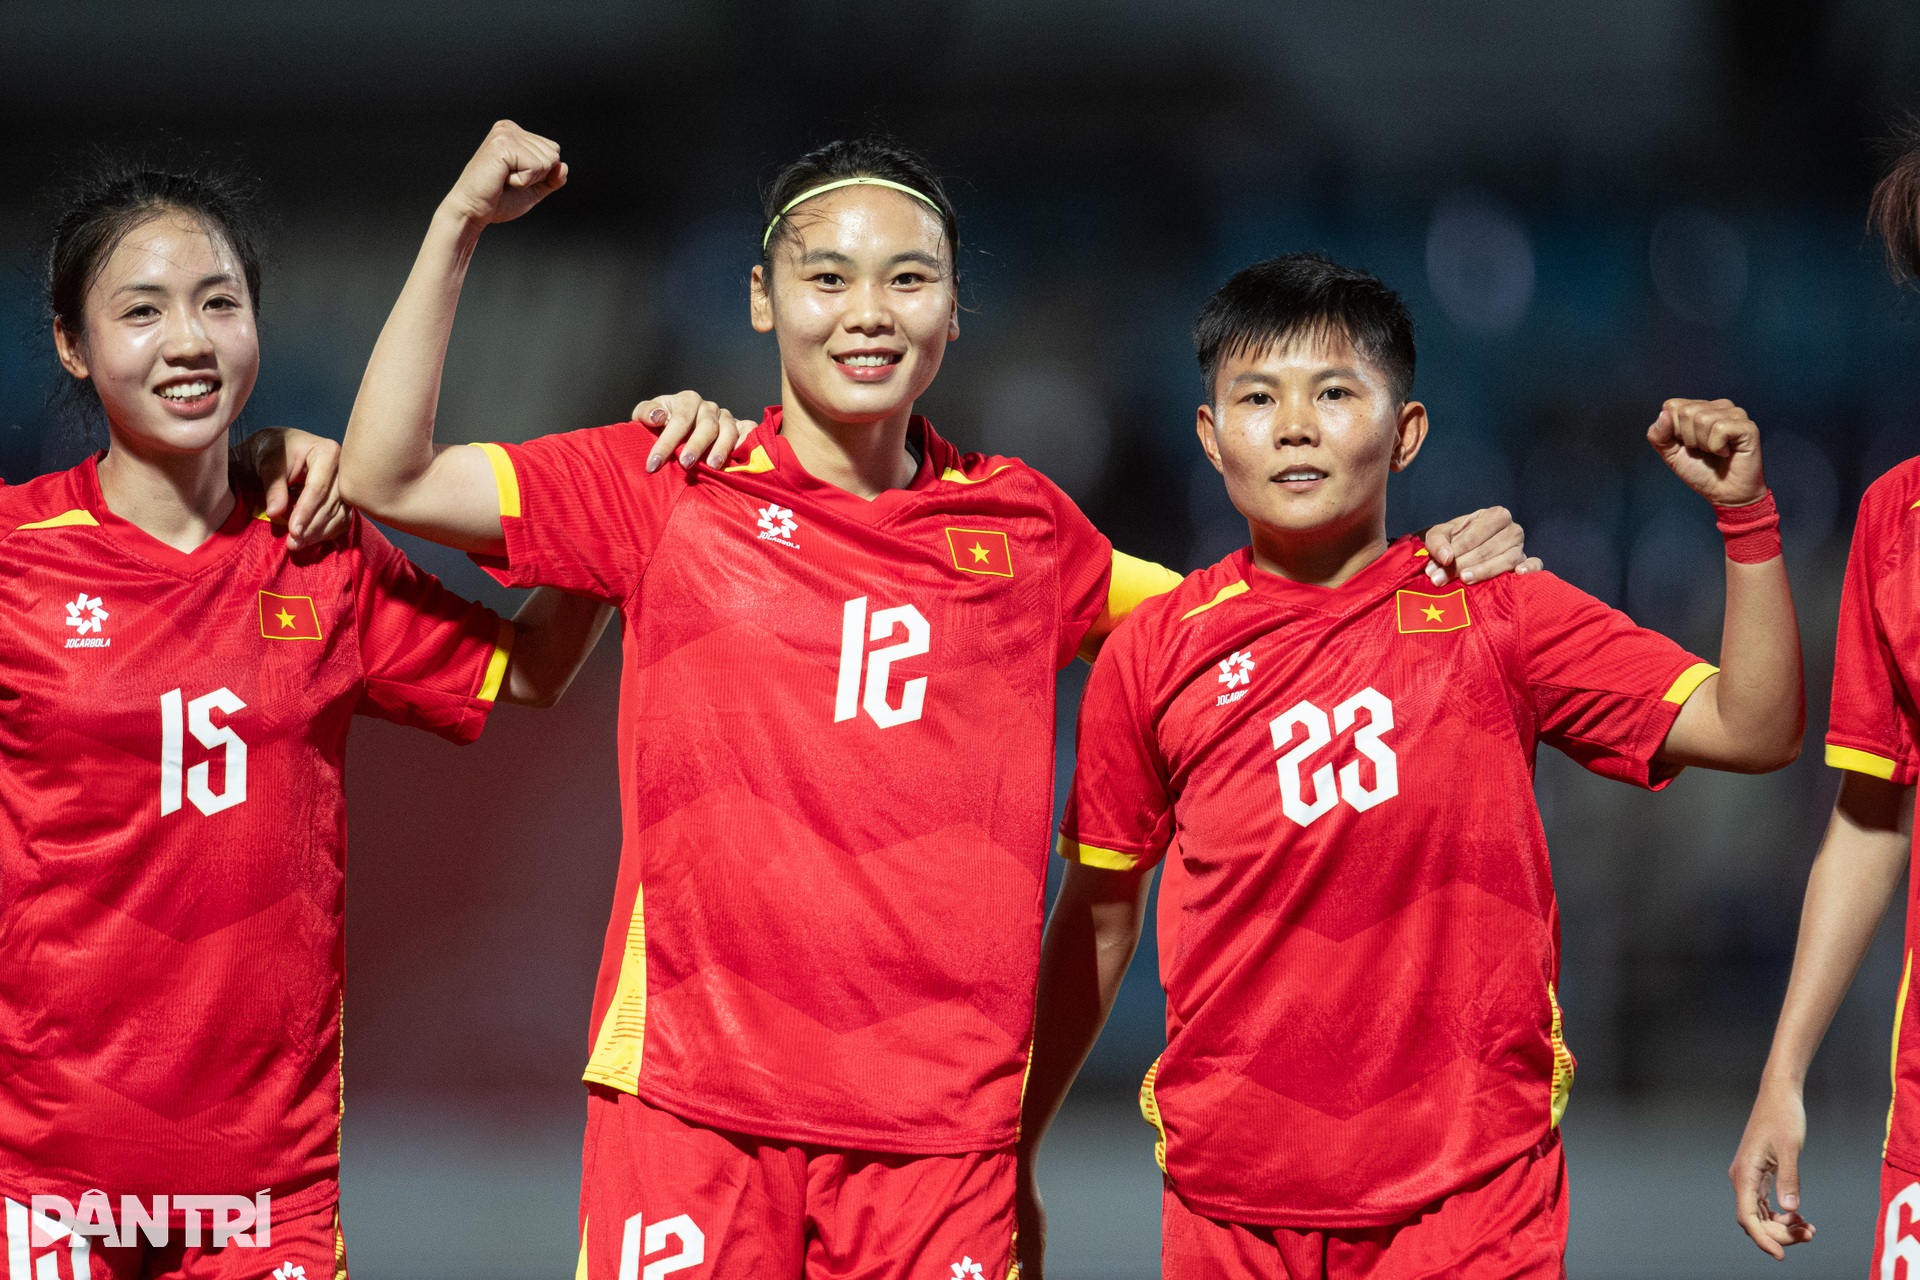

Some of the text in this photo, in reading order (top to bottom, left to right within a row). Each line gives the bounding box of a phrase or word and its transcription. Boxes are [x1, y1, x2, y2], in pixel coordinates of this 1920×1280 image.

[64, 637, 111, 649] JOGARBOLA
[833, 595, 931, 730] 12
[160, 686, 248, 817] 15
[1268, 686, 1399, 828] 23
